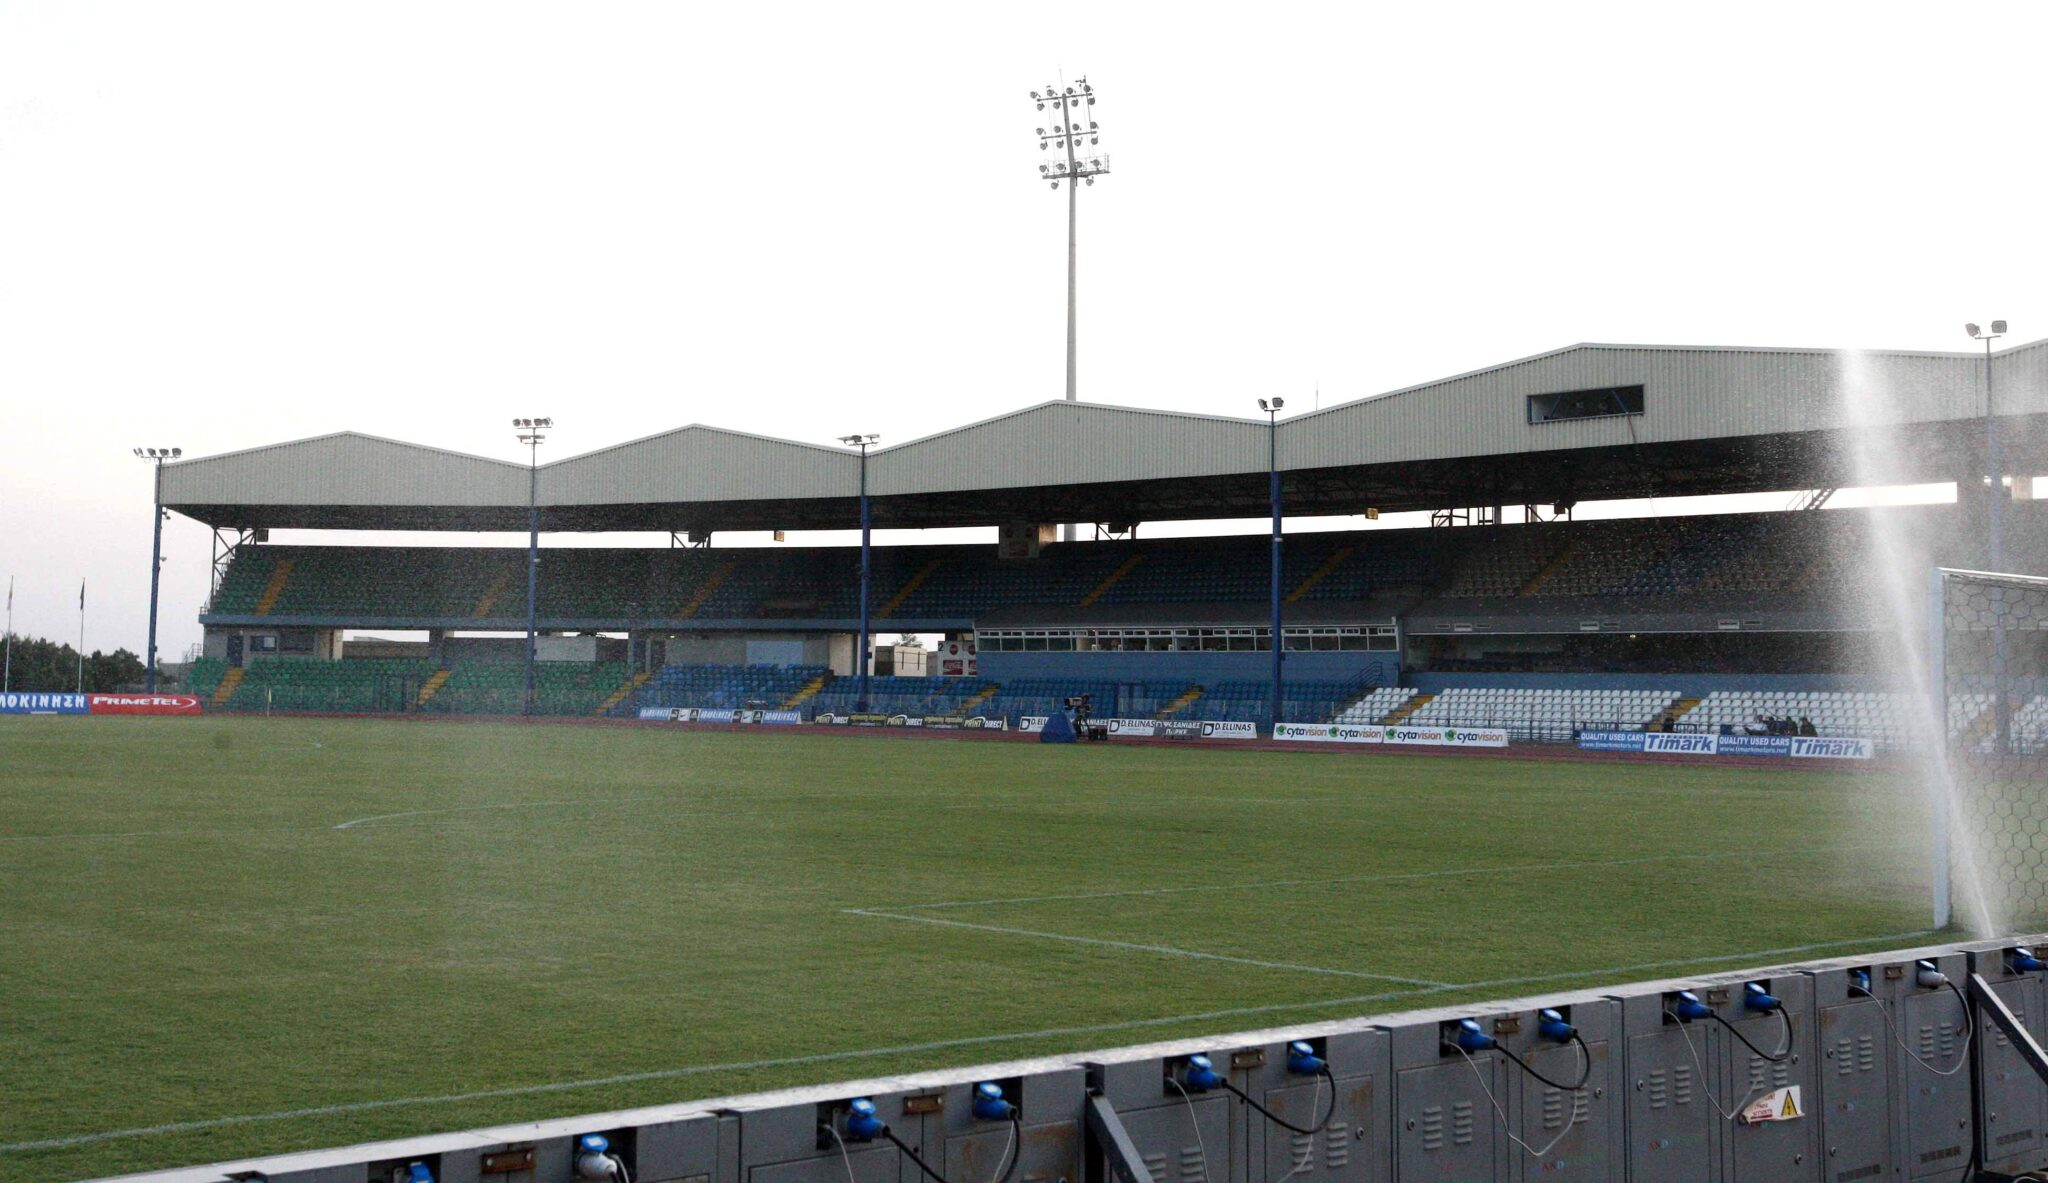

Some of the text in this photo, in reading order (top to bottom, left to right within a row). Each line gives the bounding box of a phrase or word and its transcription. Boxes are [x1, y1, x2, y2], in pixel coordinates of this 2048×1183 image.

[832, 716, 849, 724] DIRECT
[906, 718, 923, 726] DIRECT
[984, 720, 1003, 729] DIRECT
[1286, 727, 1327, 736] cytavision
[1339, 729, 1382, 738] cytavision
[1397, 731, 1442, 742] cytavision
[1457, 732, 1504, 742] cytavision
[1581, 732, 1644, 742] QUALITY USED CARS
[1647, 734, 1713, 751] Timark
[1719, 737, 1790, 746] QUALITY USED CARS
[1795, 739, 1865, 757] Timark
